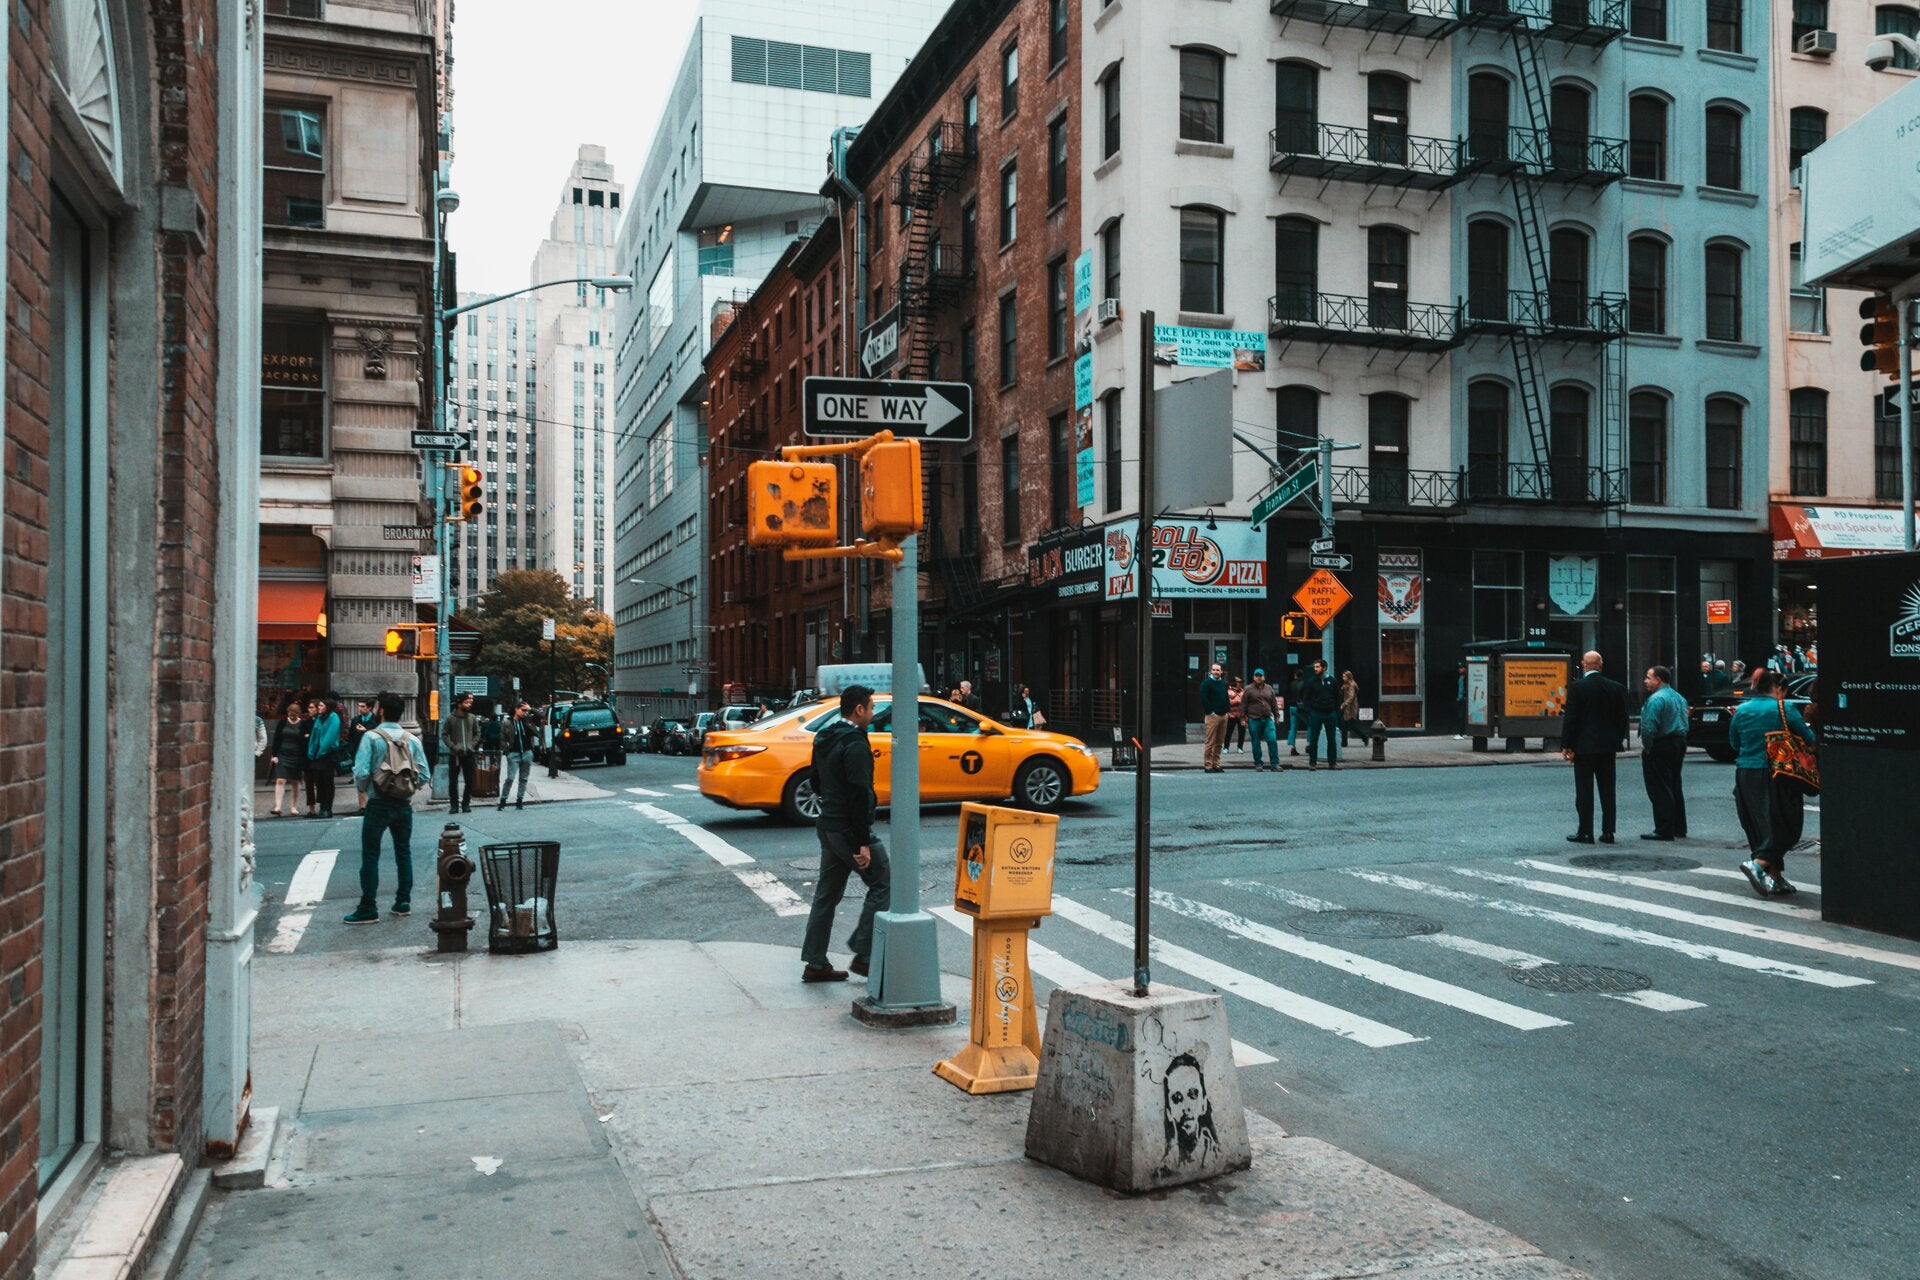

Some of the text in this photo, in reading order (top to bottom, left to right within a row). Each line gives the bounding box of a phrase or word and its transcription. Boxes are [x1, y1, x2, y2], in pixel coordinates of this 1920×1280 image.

[1153, 326, 1265, 343] FICE LOFTS FOR LEASE
[867, 325, 895, 364] ONE WAY
[263, 354, 315, 367] EXPORT
[823, 397, 928, 421] ONE WAY
[419, 436, 462, 445] ONE WAY
[1265, 478, 1299, 513] Franklin St
[1834, 511, 1895, 521] PD Properties
[384, 528, 433, 540] BROADWAY
[1814, 521, 1845, 532] Retail
[1845, 522, 1877, 534] Space
[1878, 523, 1893, 533] for
[1065, 543, 1102, 573] BURGER
[1152, 549, 1165, 568] 2
[1804, 549, 1822, 558] 358
[1229, 563, 1263, 584] PIZZA
[1308, 587, 1336, 595] TRAFFIC
[1311, 607, 1332, 616] RIGHT
[1842, 682, 1871, 690] General
[965, 755, 978, 771] T
